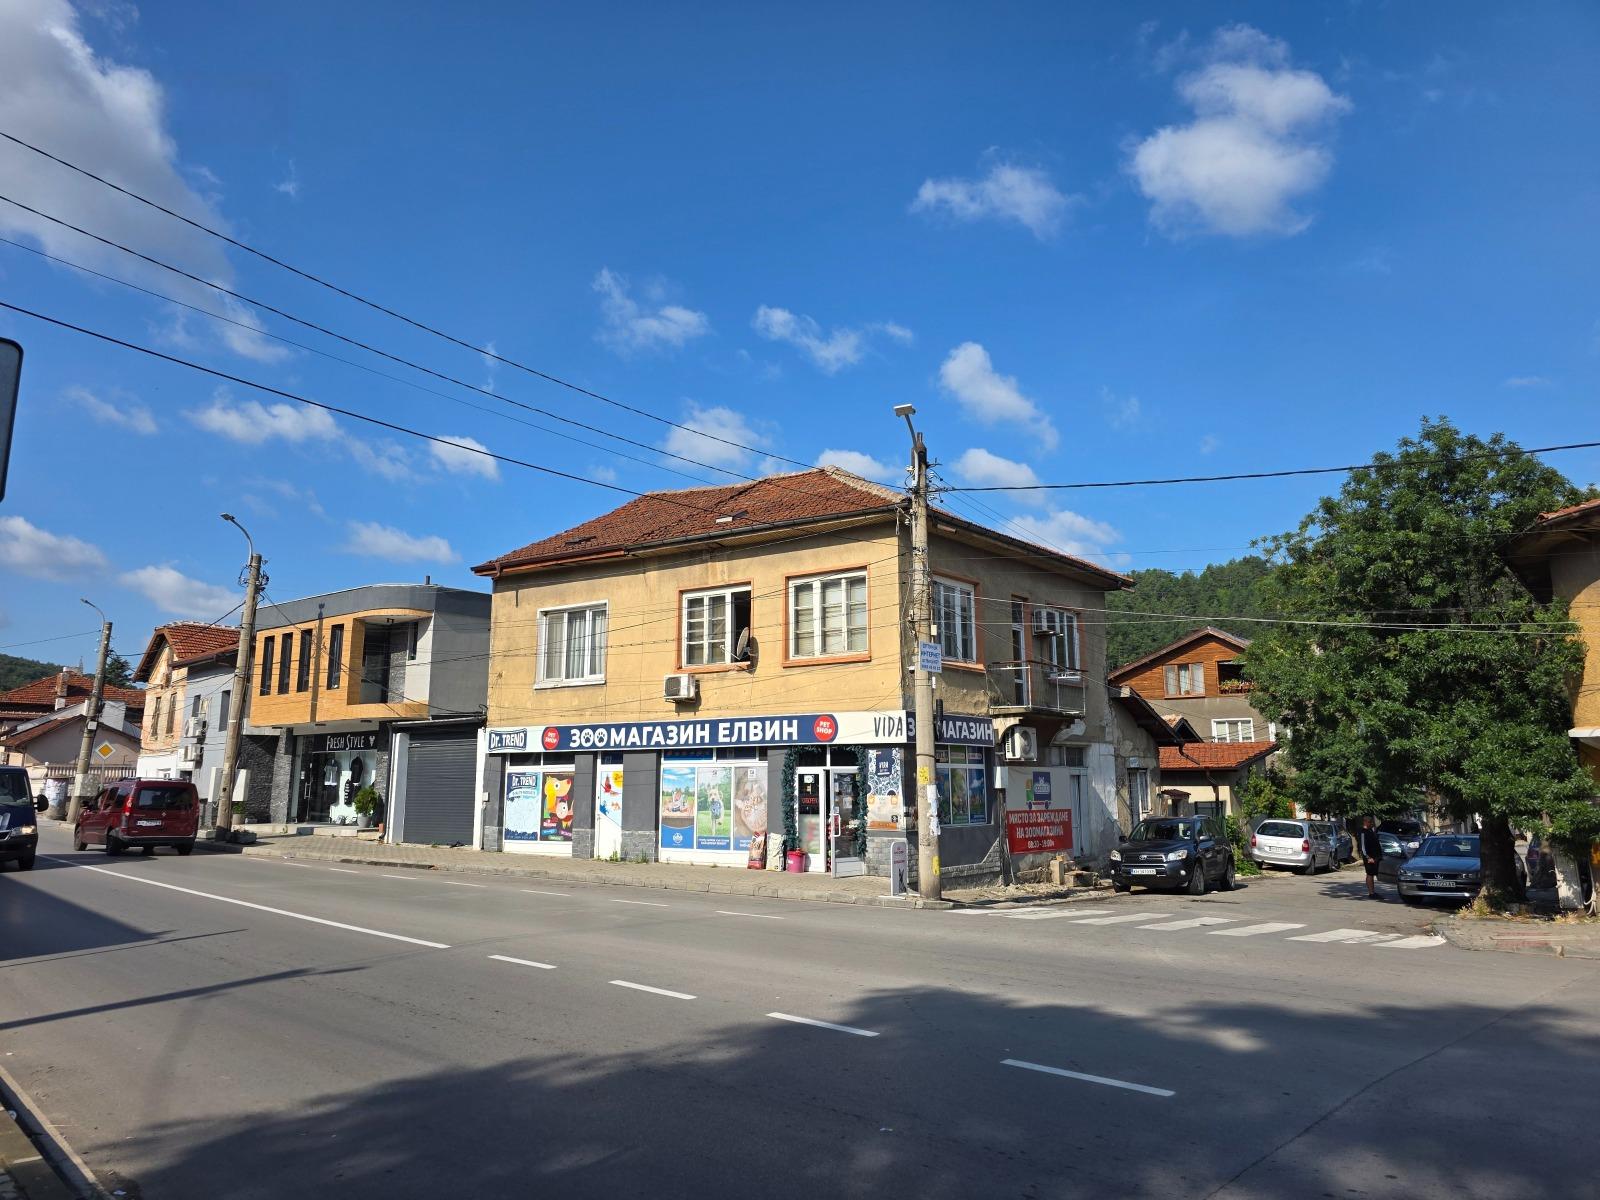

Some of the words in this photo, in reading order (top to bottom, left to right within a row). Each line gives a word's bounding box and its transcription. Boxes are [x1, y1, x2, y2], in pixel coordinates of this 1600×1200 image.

[570, 724, 710, 748] ЗООМАГАЗИН
[718, 720, 798, 743] ЕЛВИН
[816, 727, 832, 735] SHOP
[874, 716, 903, 738] VIDA
[502, 732, 525, 747] TREND
[1017, 828, 1024, 838] НА
